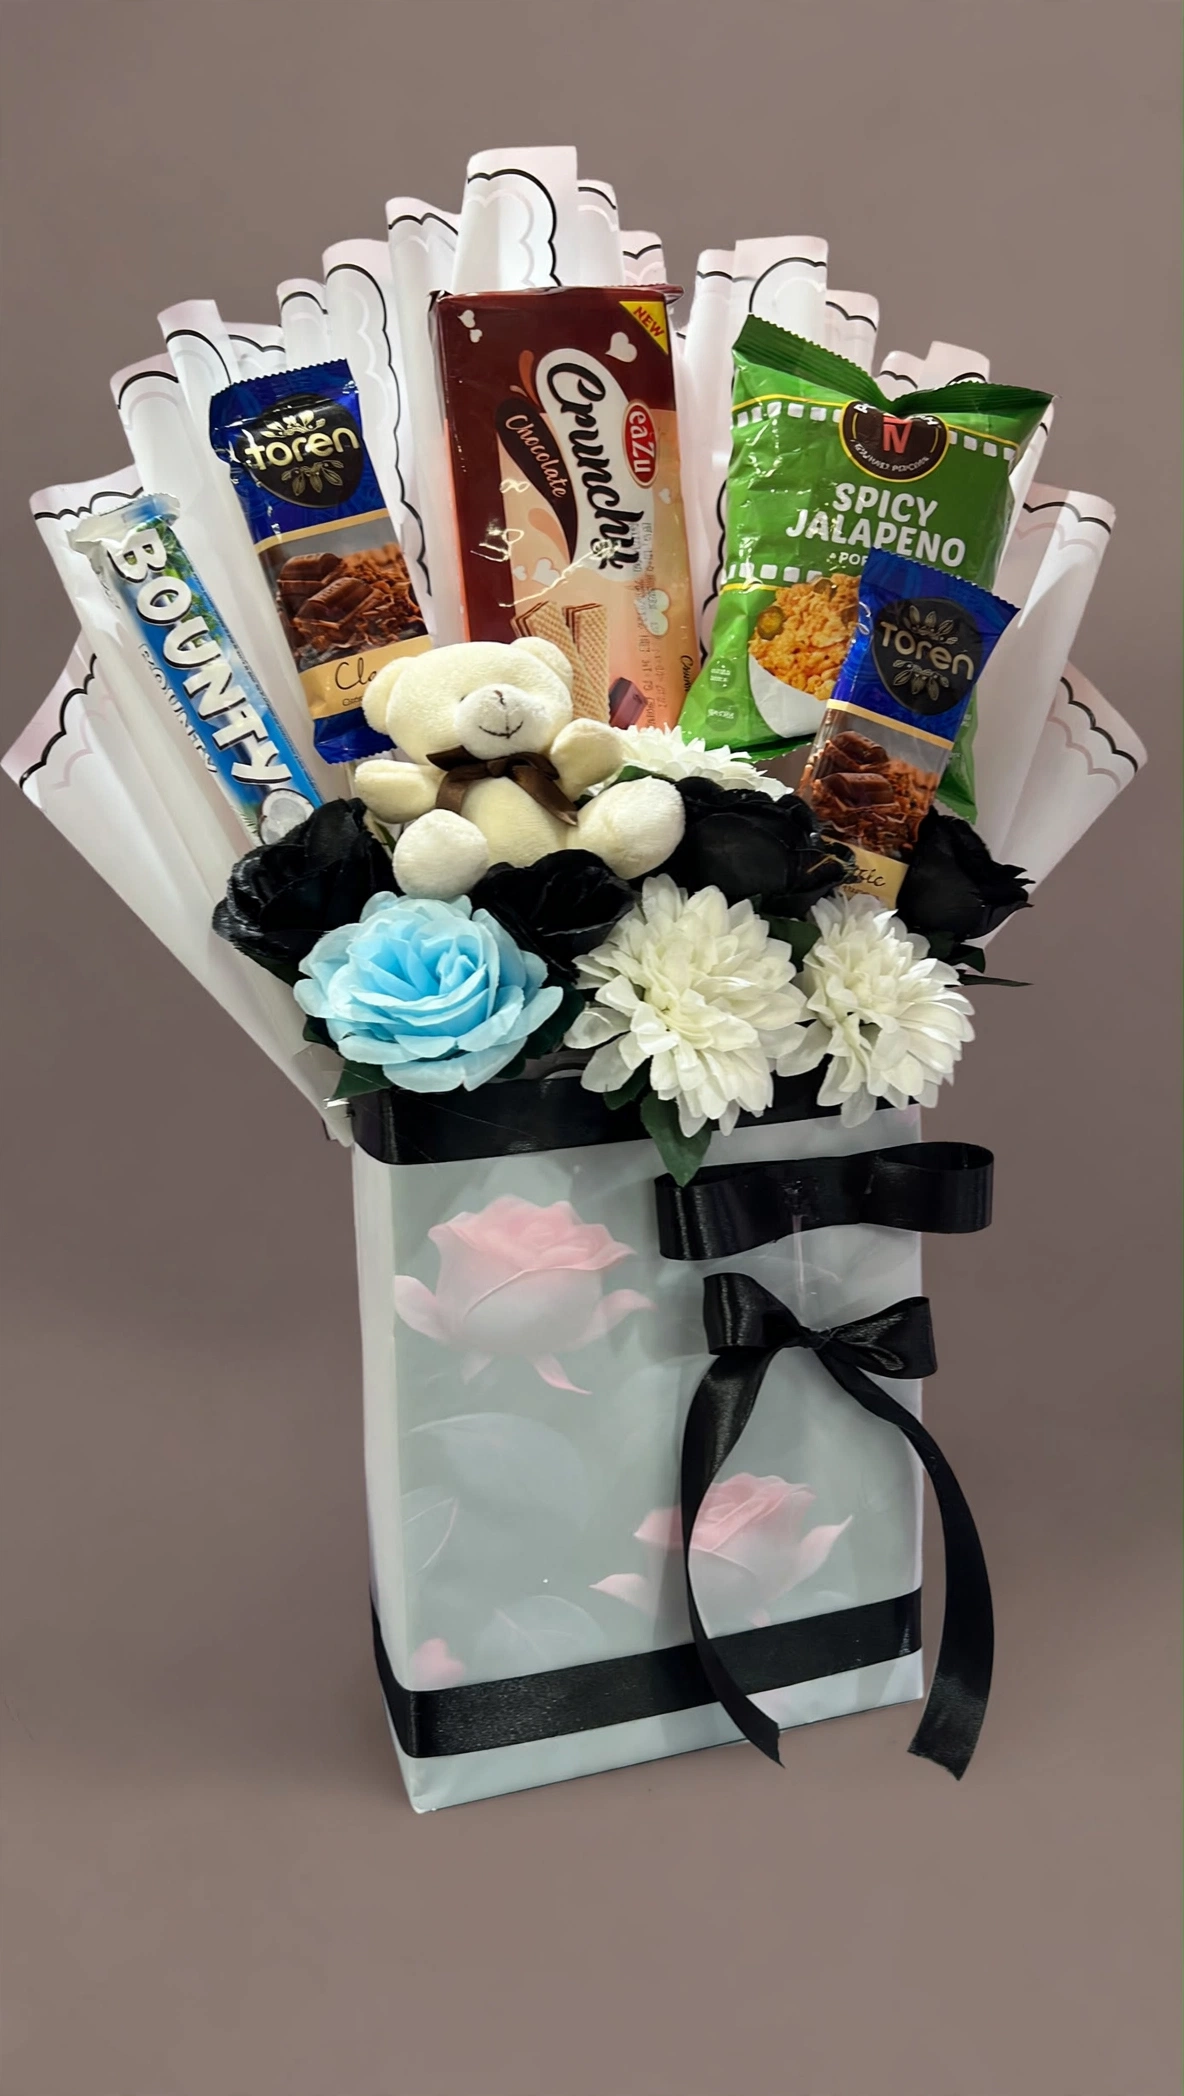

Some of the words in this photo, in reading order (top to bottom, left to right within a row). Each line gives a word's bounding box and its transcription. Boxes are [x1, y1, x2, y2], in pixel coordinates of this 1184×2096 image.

[633, 306, 665, 337] NEW
[505, 414, 568, 498] Chocolate
[546, 362, 645, 570] Crunchy
[628, 410, 652, 473] eaZu
[831, 482, 938, 527] SPICY
[785, 508, 966, 568] JALAPENO
[102, 528, 293, 785] BOUNTY
